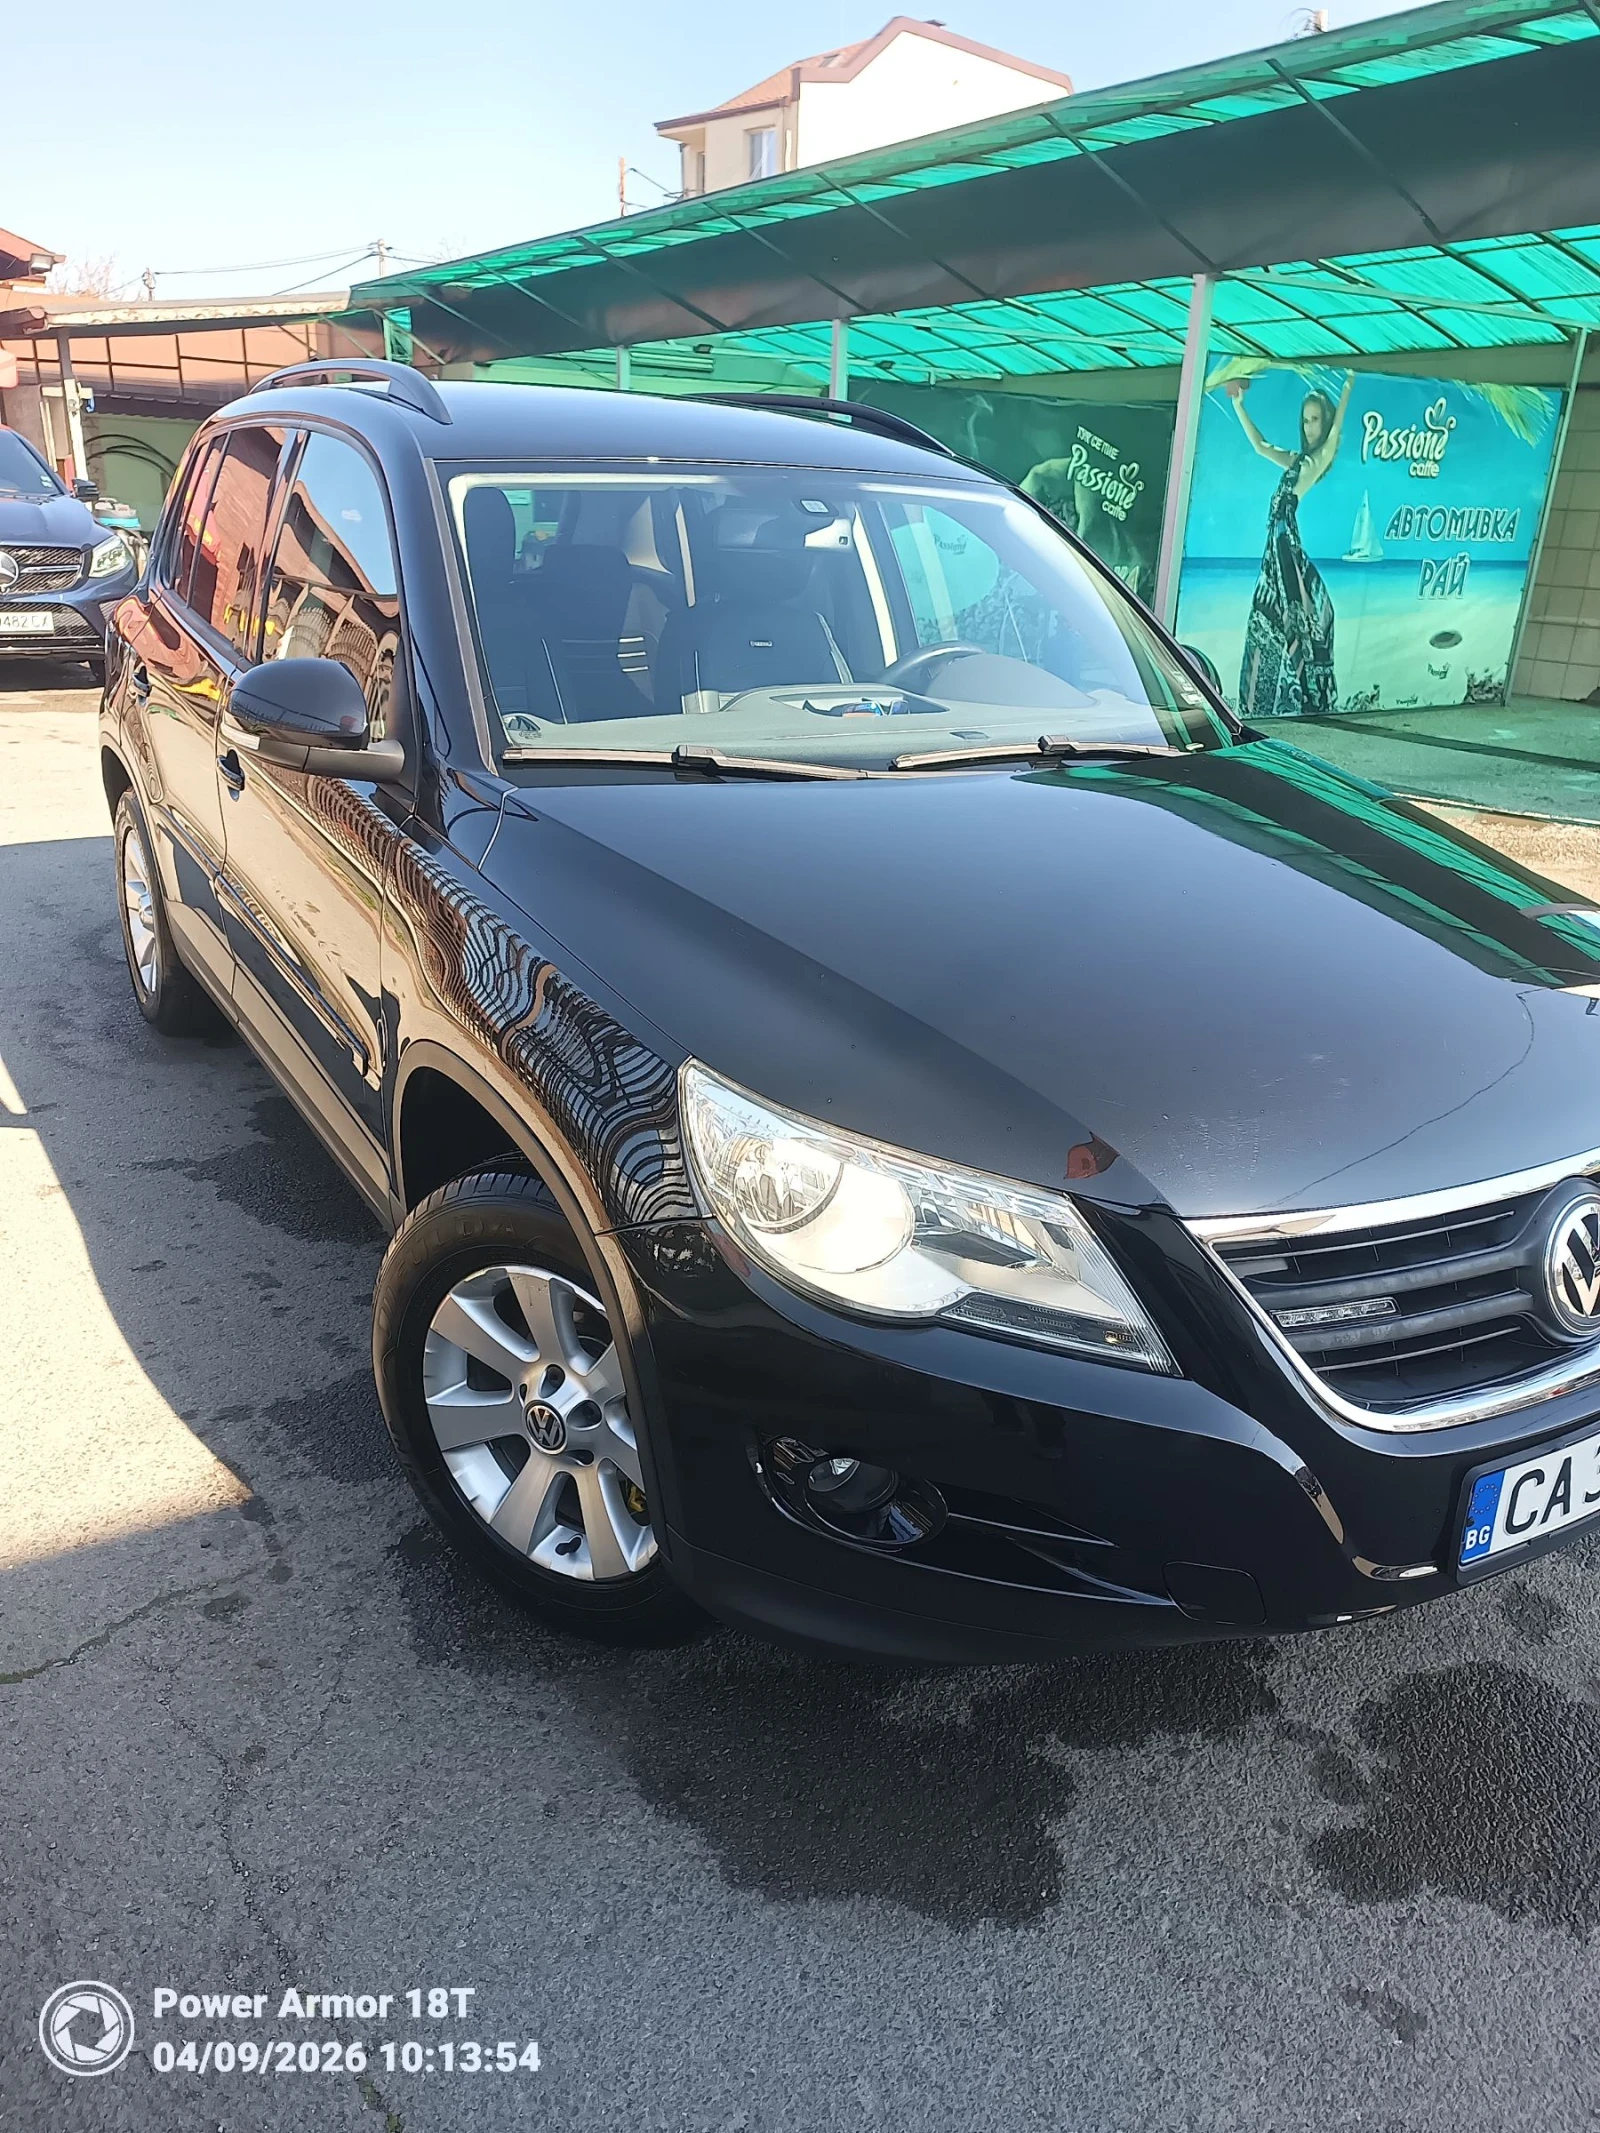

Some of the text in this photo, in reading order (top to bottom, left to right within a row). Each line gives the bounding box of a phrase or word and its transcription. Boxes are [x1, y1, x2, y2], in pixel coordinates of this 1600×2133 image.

[1361, 409, 1450, 463] Passione
[1067, 444, 1138, 510] Passione
[1410, 461, 1440, 478] caffe
[1102, 500, 1127, 522] caffe
[1384, 504, 1520, 543] АВТОМИВКА
[1418, 551, 1471, 600] РАЙ
[0, 616, 28, 628] 482
[1505, 1457, 1572, 1535] CA
[1465, 1525, 1491, 1550] BG
